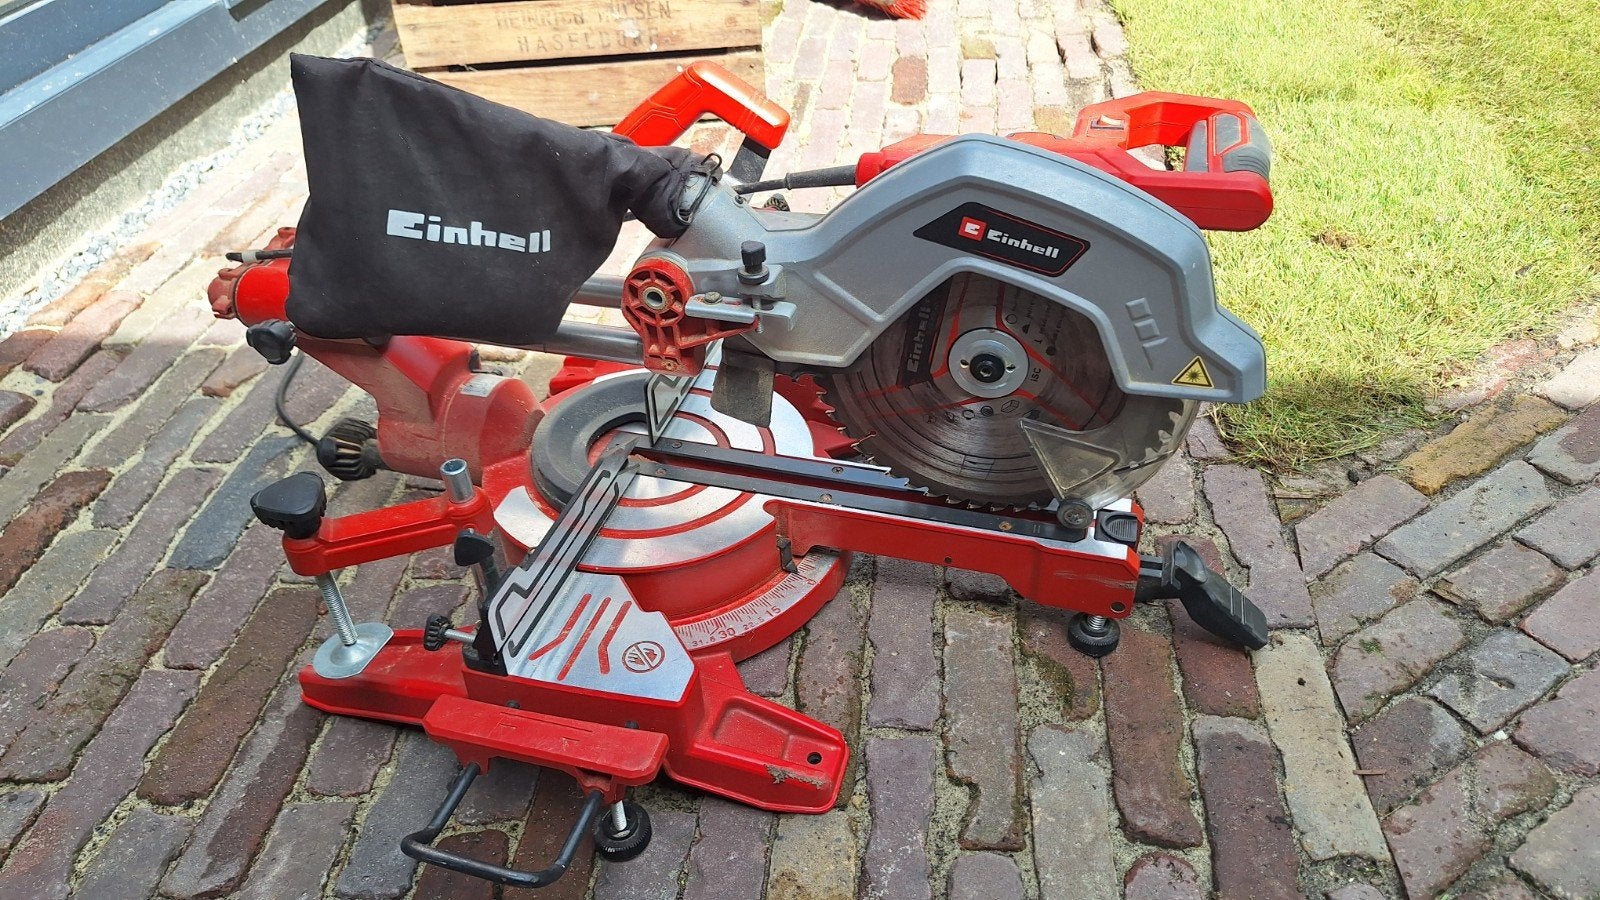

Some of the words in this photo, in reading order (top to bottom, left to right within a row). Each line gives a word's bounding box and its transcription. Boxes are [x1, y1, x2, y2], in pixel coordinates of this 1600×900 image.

[386, 209, 551, 253] Einhell
[986, 229, 1060, 259] Einhell
[907, 306, 931, 372] Einhell
[718, 627, 736, 639] 30
[765, 606, 782, 617] 15
